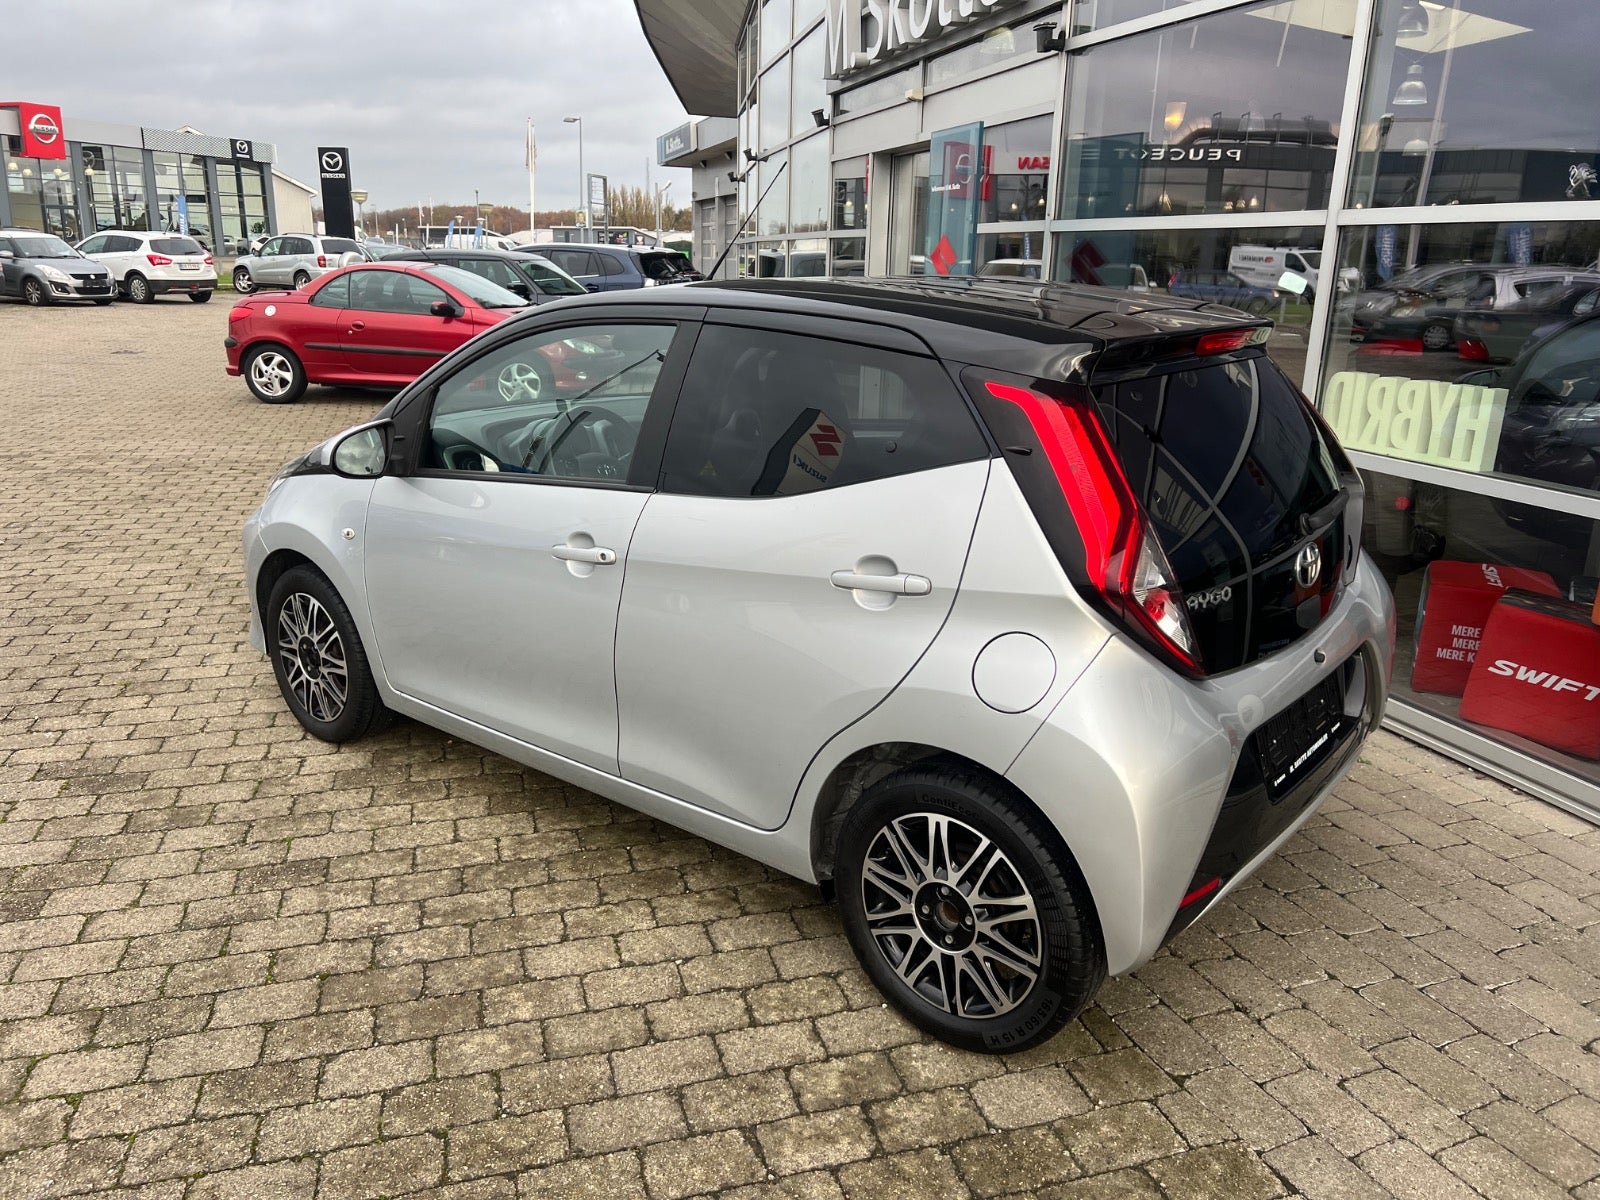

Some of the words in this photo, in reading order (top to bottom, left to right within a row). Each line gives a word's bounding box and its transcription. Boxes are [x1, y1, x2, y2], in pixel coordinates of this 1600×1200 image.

[1186, 586, 1232, 610] AYGO
[1451, 624, 1481, 639] MERE
[1436, 647, 1465, 661] MERE
[1466, 651, 1476, 664] K
[1487, 659, 1600, 701] SWIFT
